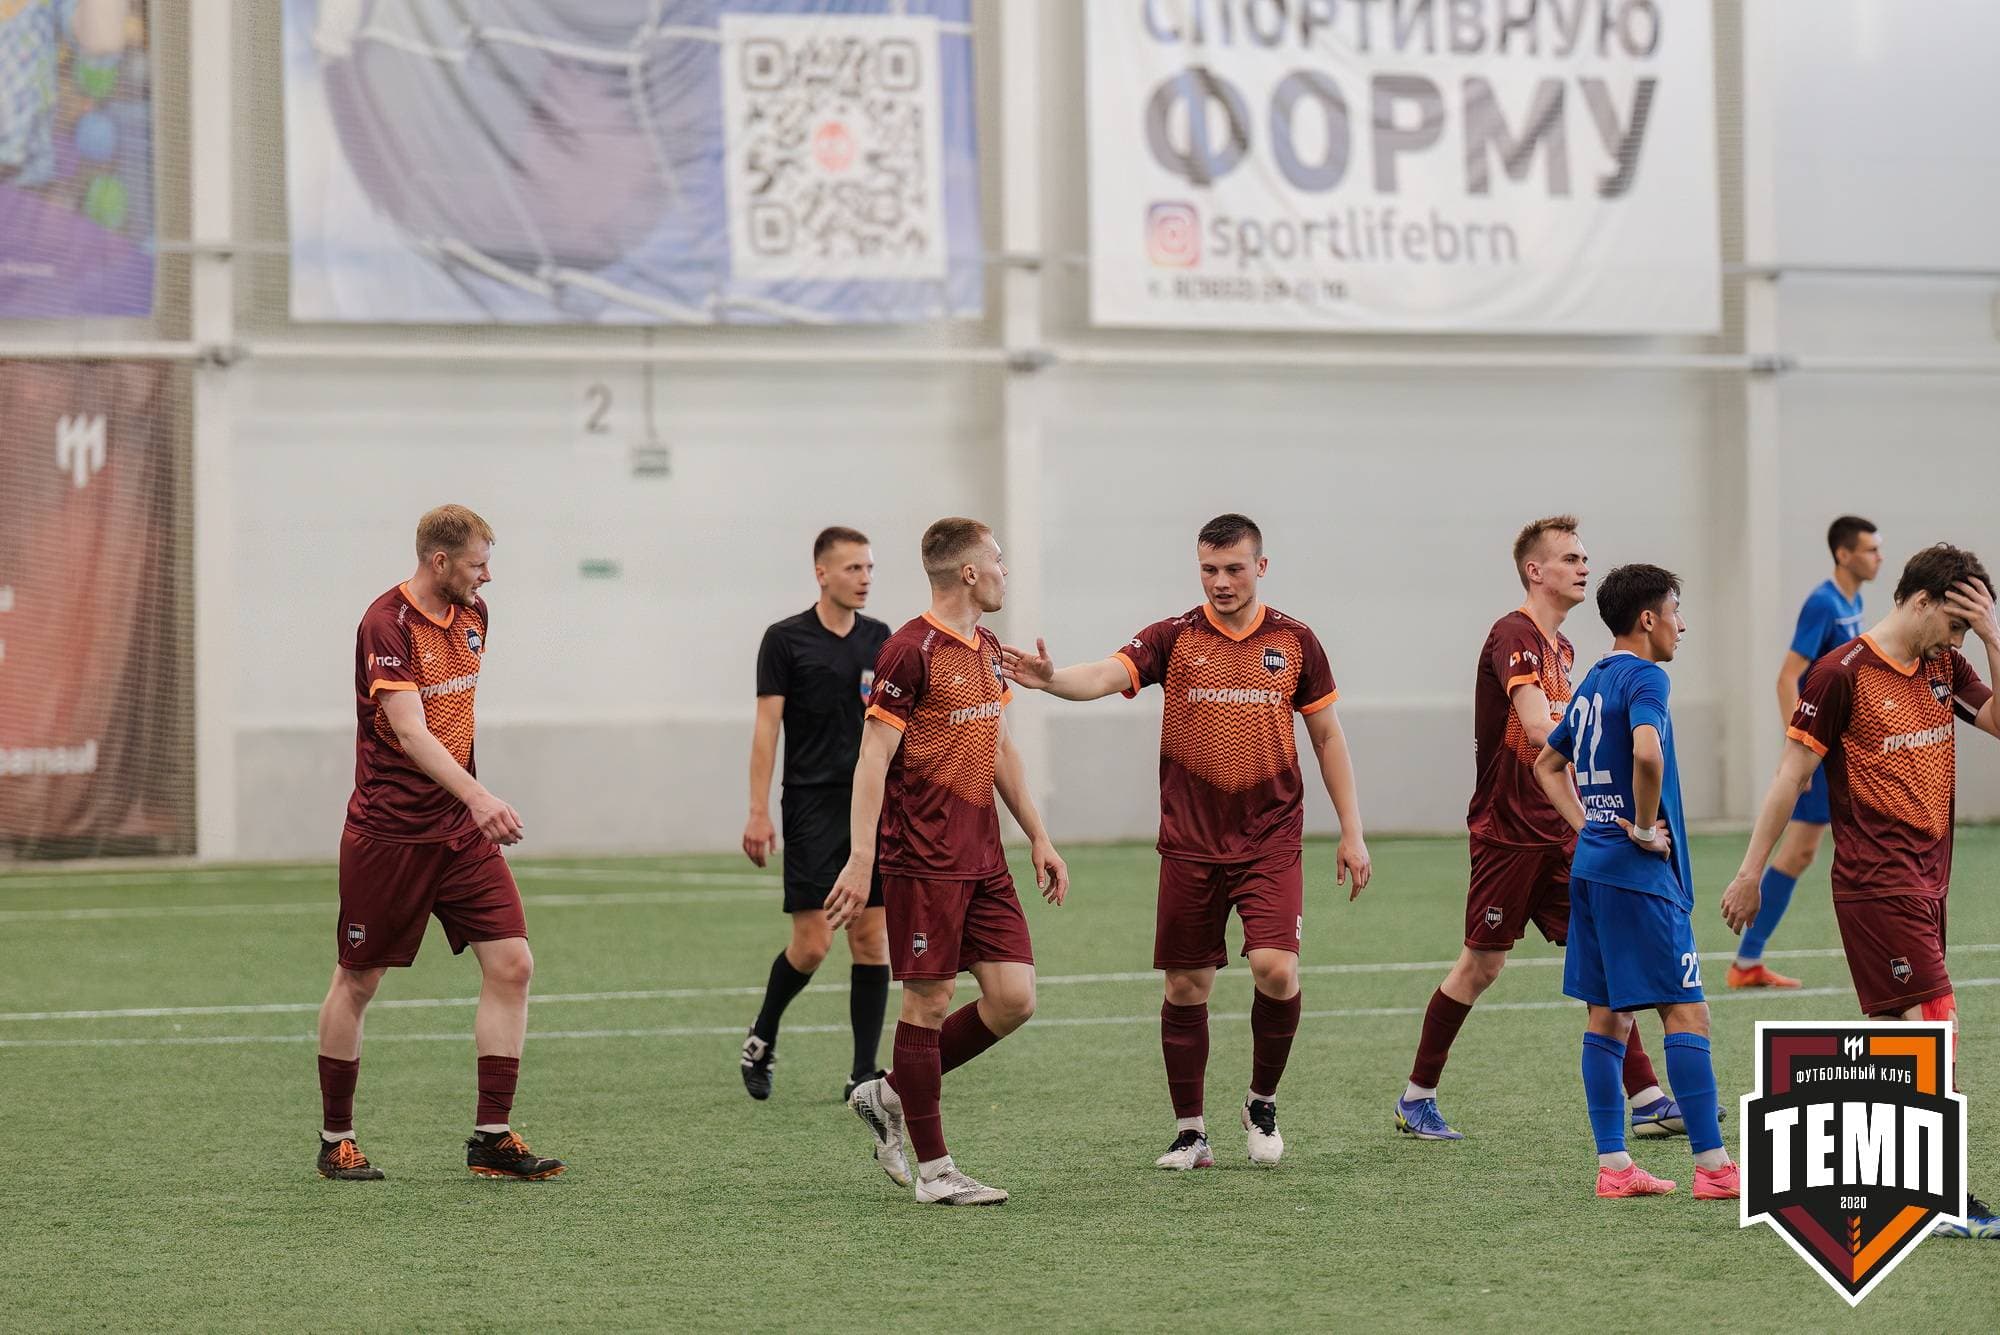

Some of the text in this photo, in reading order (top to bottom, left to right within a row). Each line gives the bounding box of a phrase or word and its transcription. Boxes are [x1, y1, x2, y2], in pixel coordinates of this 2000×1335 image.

[1143, 0, 1660, 57] СПОРТИВНУЮ
[1144, 65, 1658, 200] ФОРМУ
[1209, 207, 1519, 268] sportlifebrn
[585, 383, 614, 434] 2
[375, 656, 402, 667] ПСБ
[1264, 655, 1285, 669] ТЕМП
[1569, 692, 1613, 787] 22
